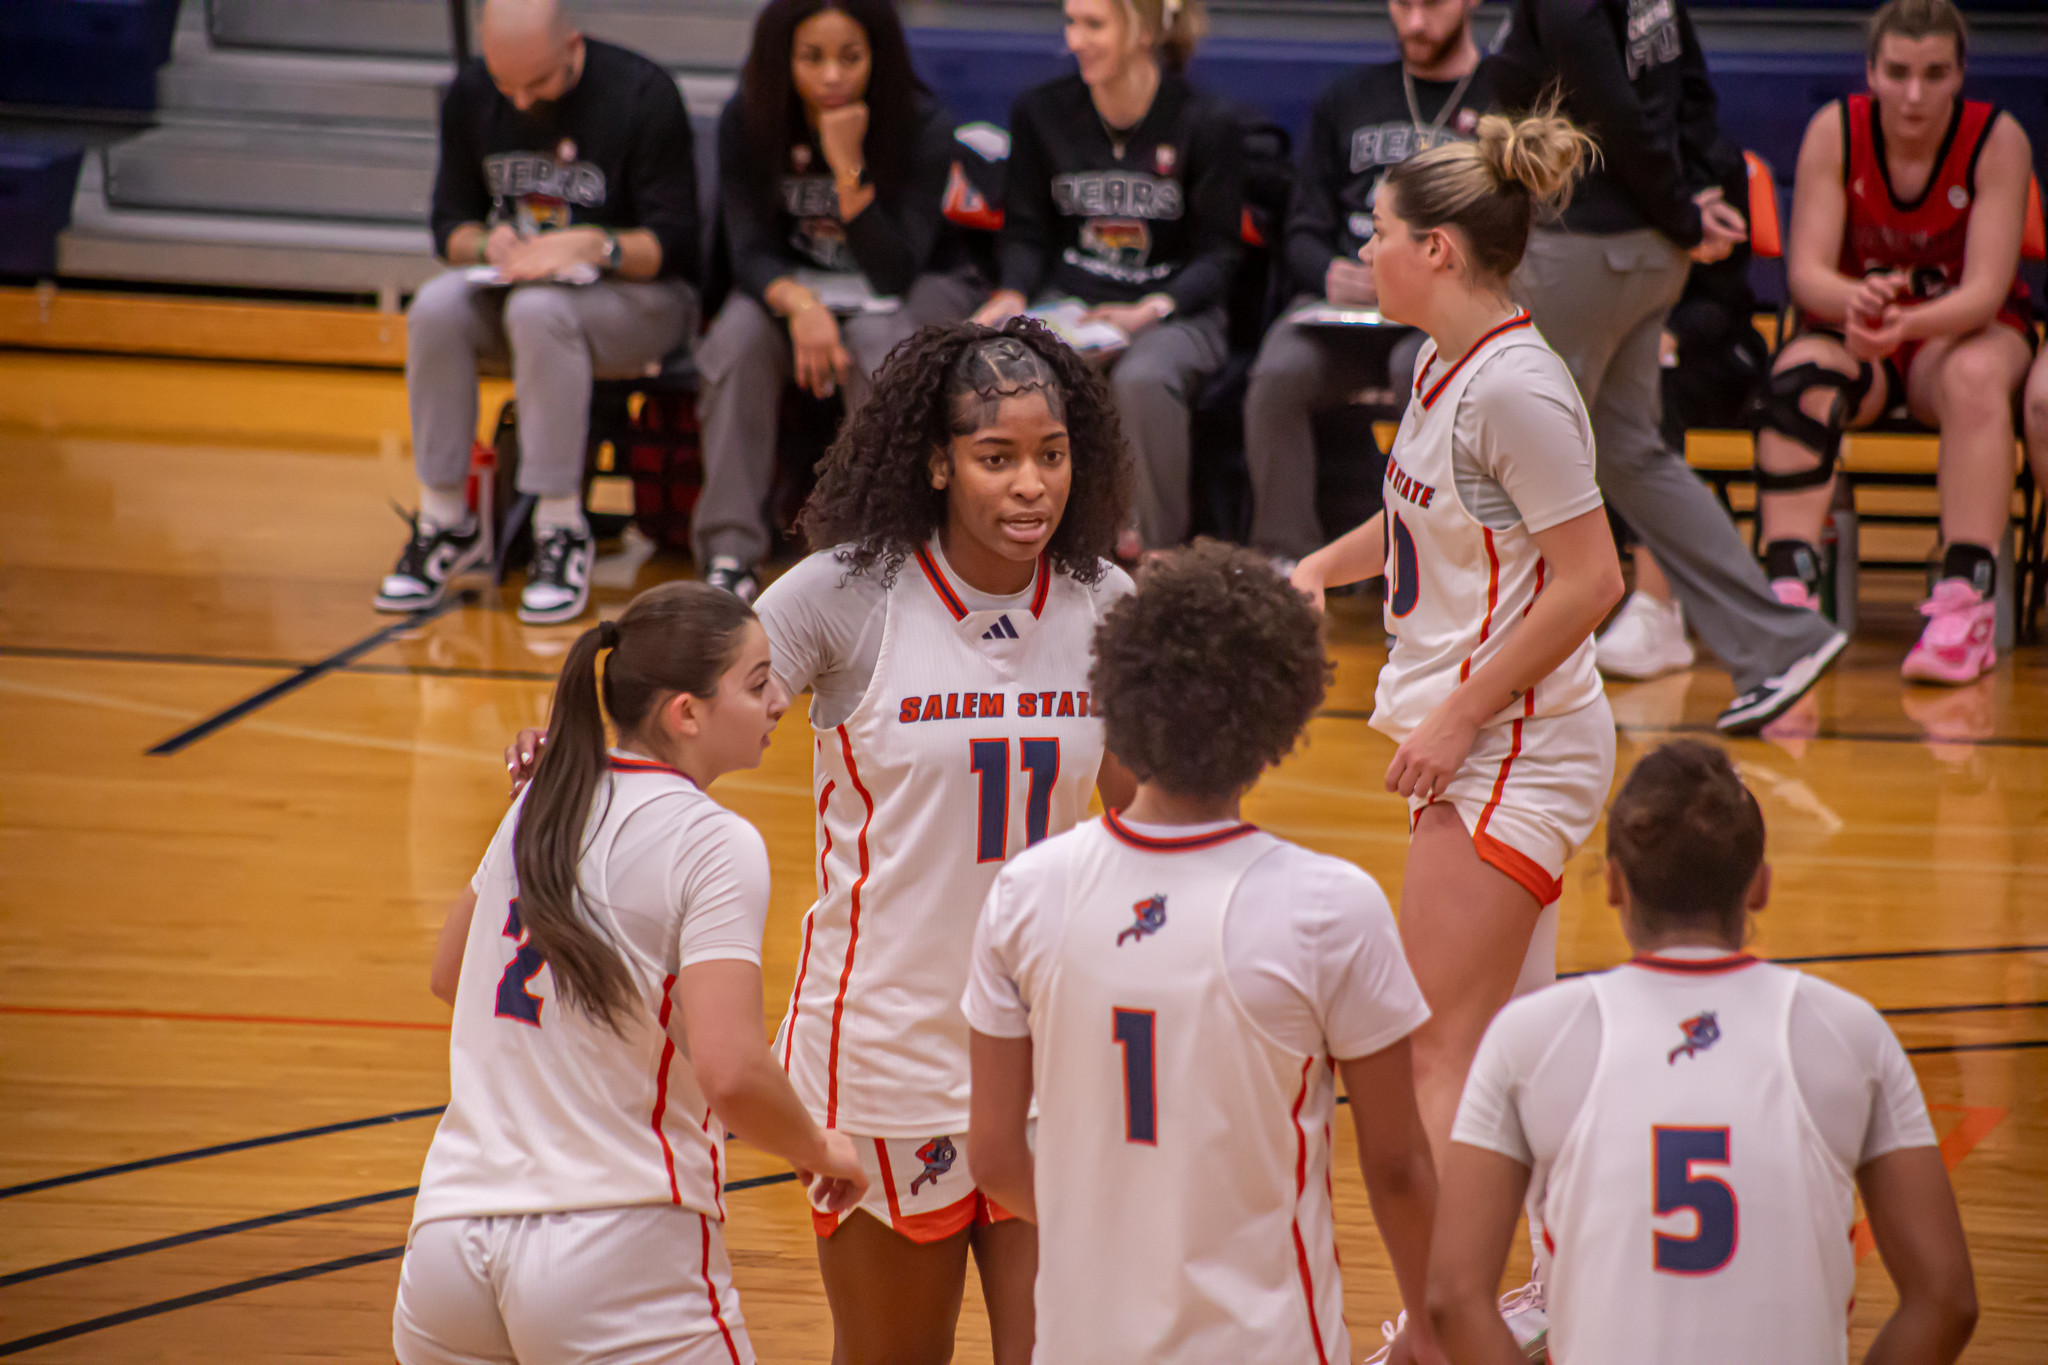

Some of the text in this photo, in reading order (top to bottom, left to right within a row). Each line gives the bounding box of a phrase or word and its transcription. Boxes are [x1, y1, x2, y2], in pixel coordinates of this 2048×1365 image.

[1383, 499, 1419, 618] 0
[899, 692, 1005, 724] SALEM
[969, 737, 1060, 864] 11
[494, 897, 546, 1029] 2
[1111, 1006, 1157, 1147] 1
[1651, 1124, 1739, 1277] 5
